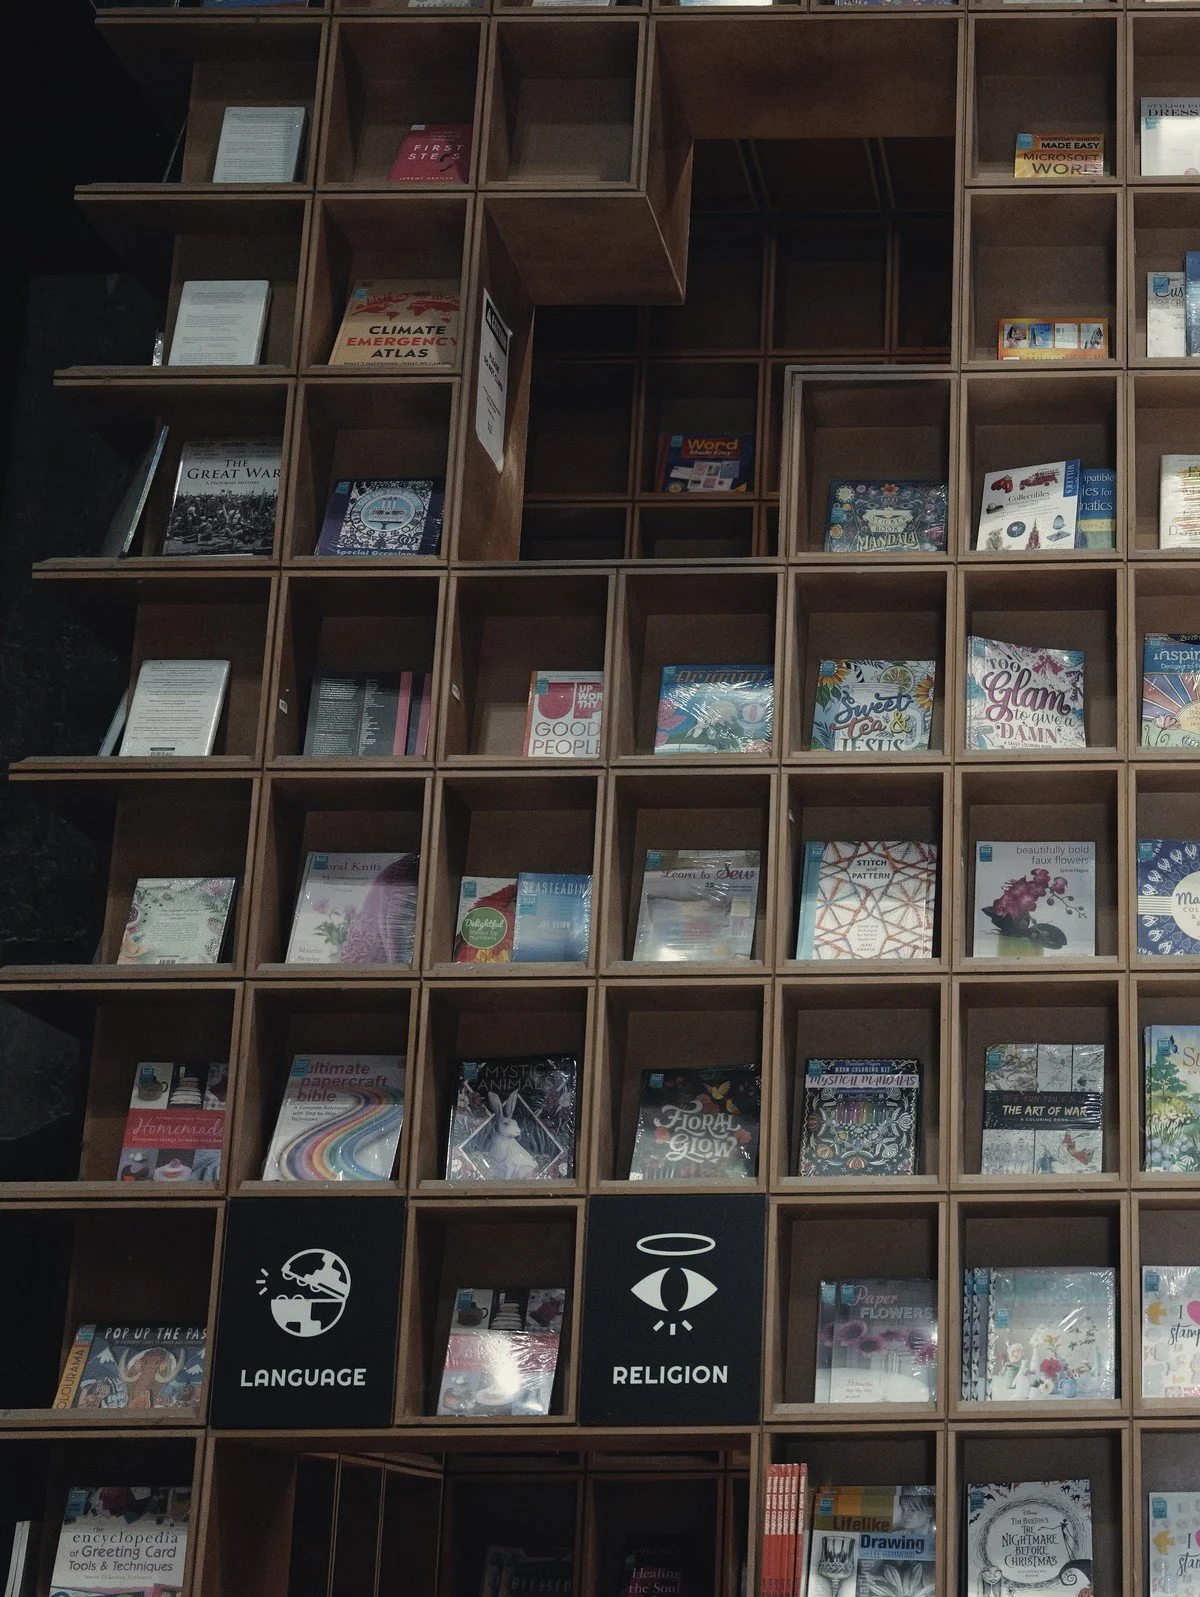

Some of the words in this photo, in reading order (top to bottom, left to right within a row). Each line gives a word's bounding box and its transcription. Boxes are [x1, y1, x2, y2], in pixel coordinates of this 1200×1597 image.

[414, 144, 465, 152] FIRST
[1074, 142, 1099, 150] EASY
[369, 326, 446, 335] CLIMATE
[347, 337, 457, 347] EMERGENCY
[370, 349, 429, 358] ATLAS
[688, 439, 739, 450] Word
[225, 459, 249, 468] THE
[187, 469, 240, 480] GREAT
[246, 468, 282, 479] WAR
[857, 533, 919, 551] MANDALA
[987, 658, 1021, 673] TOO
[579, 685, 594, 693] UP
[982, 668, 1071, 723] Glam
[834, 690, 914, 723] Sweet
[535, 721, 600, 736] GOOD
[829, 717, 886, 740] tea
[889, 711, 912, 734] &
[995, 721, 1058, 744] DAMN
[1016, 845, 1066, 856] beautifully
[1068, 845, 1089, 854] bold
[856, 859, 887, 867] STITCH
[1032, 855, 1053, 864] faux
[1056, 855, 1089, 864] flowers
[660, 868, 697, 880] Learn
[700, 871, 710, 879] to
[716, 860, 755, 880] Sew
[464, 917, 505, 930] Delightful
[485, 1063, 544, 1077] MYSTIC
[301, 1075, 389, 1090] papercraft
[477, 1077, 553, 1091] ANIMALS
[297, 1089, 336, 1103] bible
[654, 1100, 742, 1136] FLORAL
[1002, 1105, 1022, 1116] THE
[1025, 1105, 1046, 1116] ART
[1047, 1105, 1061, 1116] OF
[1064, 1105, 1086, 1117] WAR
[666, 1132, 738, 1163] GLOW
[854, 1285, 898, 1306] Paper
[860, 1305, 934, 1320] FLOWERS
[104, 1328, 130, 1341] POP
[134, 1328, 151, 1339] UP
[156, 1327, 182, 1339] THE
[240, 1368, 367, 1387] LANGUAGE
[612, 1365, 729, 1385] RELIGION
[832, 1516, 890, 1533] Lifelike
[1021, 1525, 1034, 1535] THE
[72, 1532, 179, 1549] encyclopedia
[860, 1534, 926, 1553] Drawing
[1001, 1534, 1059, 1547] NIGHTMARE
[69, 1549, 79, 1559] of
[81, 1546, 141, 1560] Greeting
[145, 1546, 177, 1558] Card
[1015, 1545, 1047, 1556] BEFORE
[69, 1561, 97, 1571] Tools
[100, 1562, 108, 1571] &
[112, 1561, 173, 1574] Techniques
[1004, 1554, 1058, 1569] CHRISTMAS
[631, 1567, 682, 1582] Healing
[629, 1582, 649, 1594] the
[653, 1581, 682, 1594] Soul
